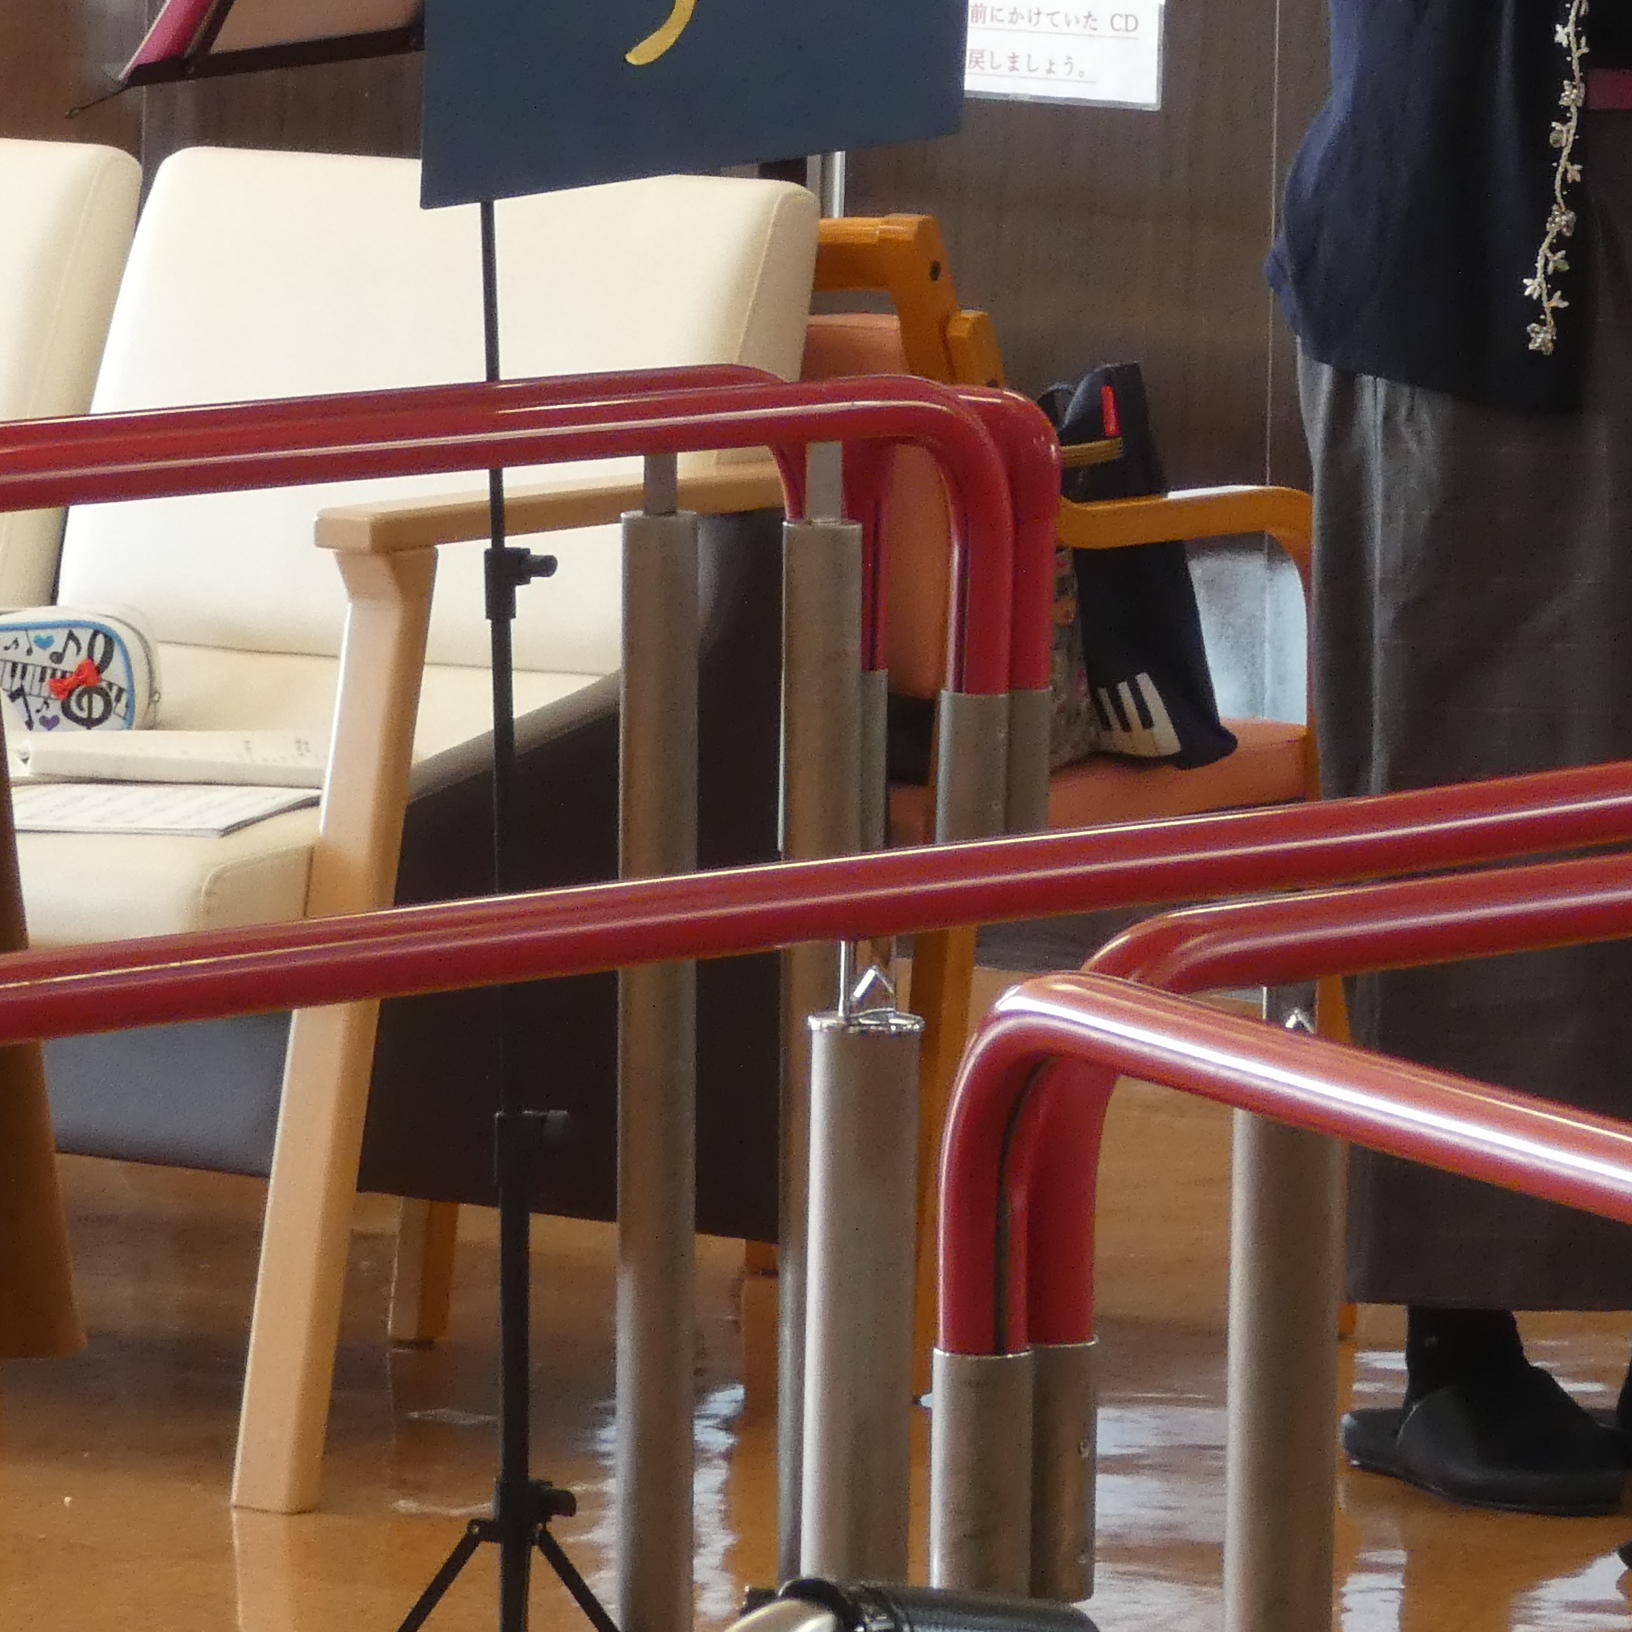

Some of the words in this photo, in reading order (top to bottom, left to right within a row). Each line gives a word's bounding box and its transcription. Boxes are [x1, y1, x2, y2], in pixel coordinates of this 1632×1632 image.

[969, 1, 1099, 32] 前にかけていた
[1109, 12, 1140, 33] CD
[967, 48, 1086, 79] 戻しましょう。
